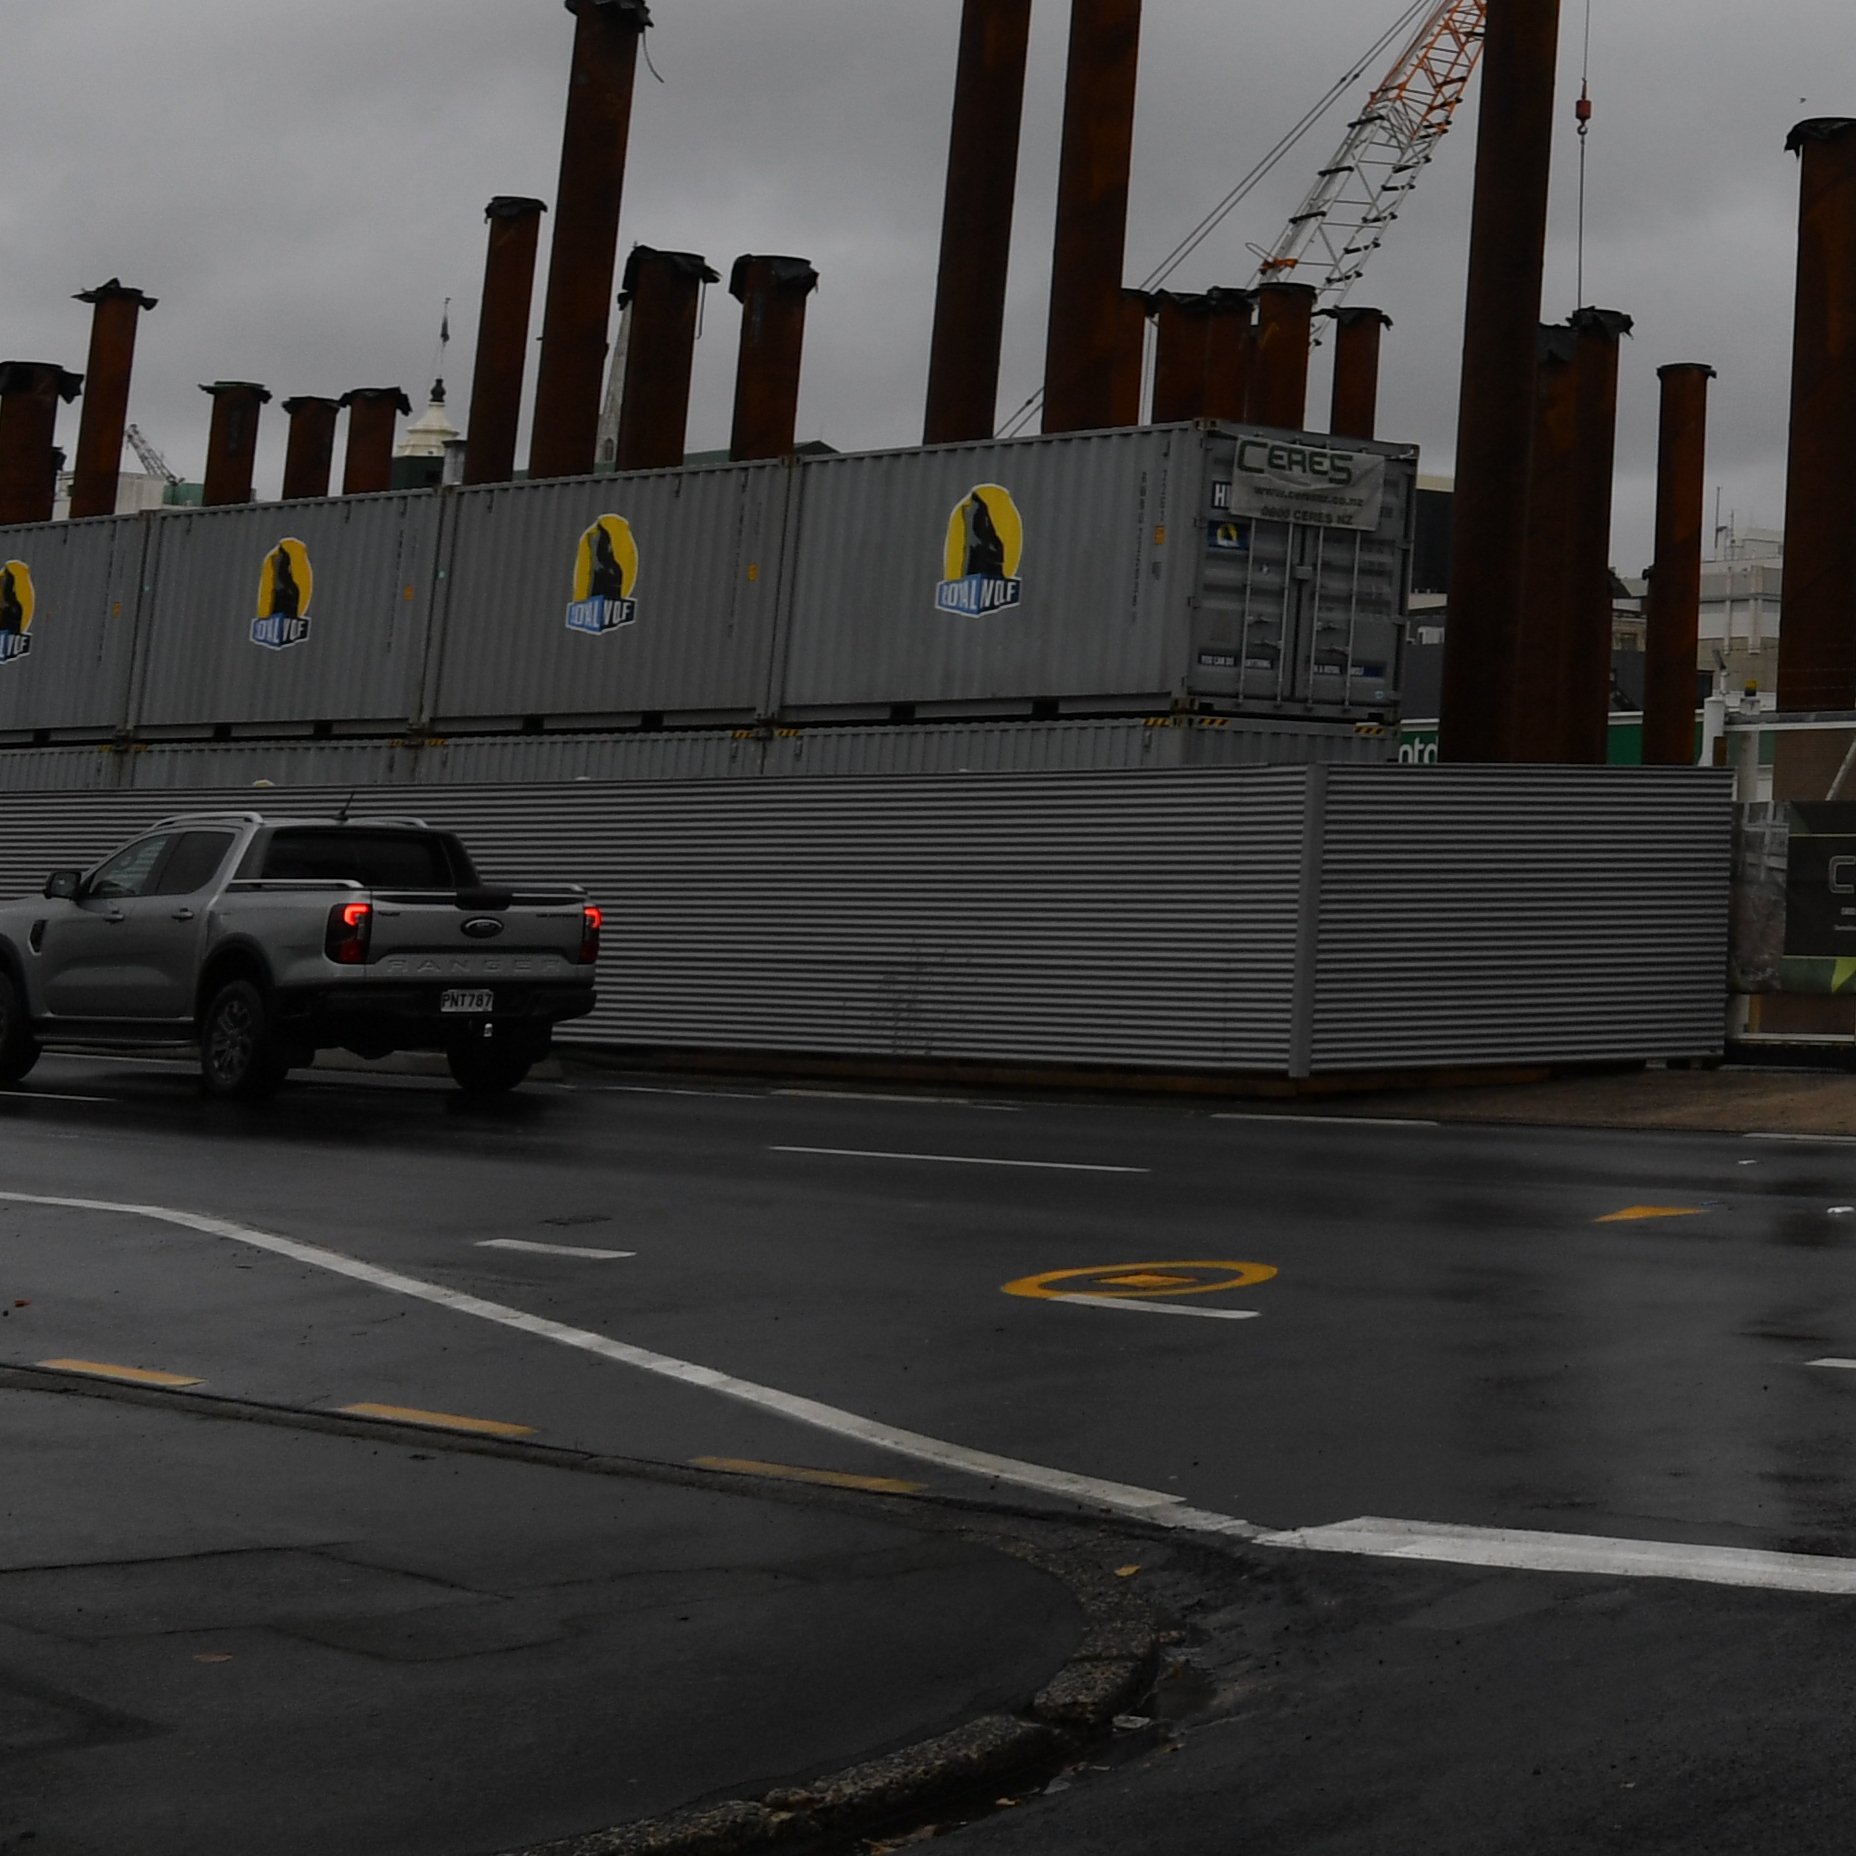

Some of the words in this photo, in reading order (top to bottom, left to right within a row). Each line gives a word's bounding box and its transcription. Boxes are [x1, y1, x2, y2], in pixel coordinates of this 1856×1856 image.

[1237, 440, 1354, 485] CERES
[1293, 509, 1333, 524] CERES
[1337, 514, 1354, 525] NZ
[387, 959, 561, 973] RANGER
[441, 994, 492, 1009] PNT787
